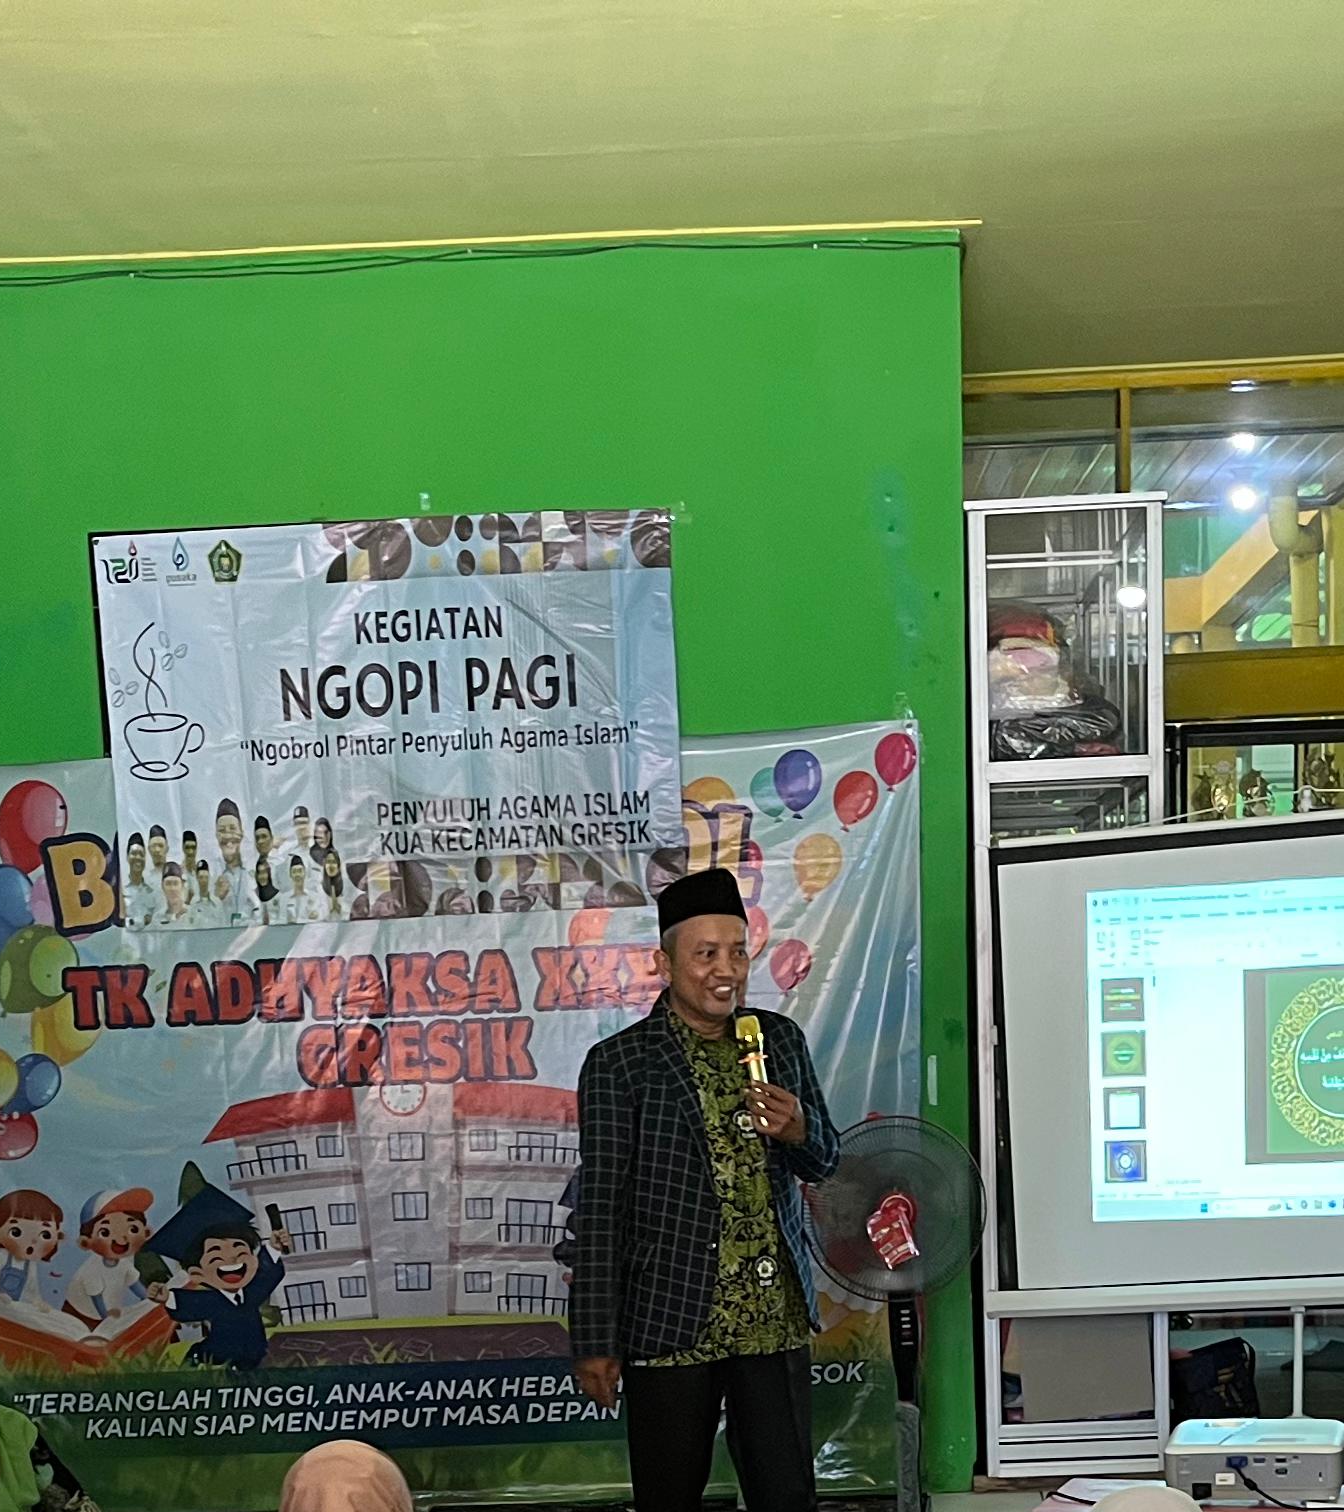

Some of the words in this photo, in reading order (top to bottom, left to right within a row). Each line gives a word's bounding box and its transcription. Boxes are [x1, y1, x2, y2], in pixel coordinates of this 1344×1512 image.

[354, 606, 503, 645] KEGIATAN
[279, 659, 441, 722] NGOPI
[465, 653, 578, 712] PAGI
[337, 733, 396, 757] Pintar
[402, 727, 493, 760] Penyuluh
[499, 725, 569, 753] Agama
[377, 797, 491, 826] PENYULUH
[498, 794, 577, 820] AGAMA
[583, 790, 651, 816] ISLAM
[381, 831, 424, 856] KUA
[431, 824, 564, 854] KECAMATAN
[571, 820, 652, 847] GRESIK
[62, 965, 155, 1031] TK
[166, 949, 523, 1029] ADHYAKSA
[297, 1016, 538, 1088] GRESIK
[217, 1383, 320, 1409] TINGGI,
[325, 1377, 498, 1405] ANAK-ANAK
[810, 1360, 865, 1386] SOK
[85, 1416, 187, 1440] KALIAN
[193, 1413, 256, 1436] SIAP
[261, 1405, 438, 1434] MENJEMPUT
[442, 1402, 521, 1427] MASA
[526, 1399, 621, 1424] DEPAN
